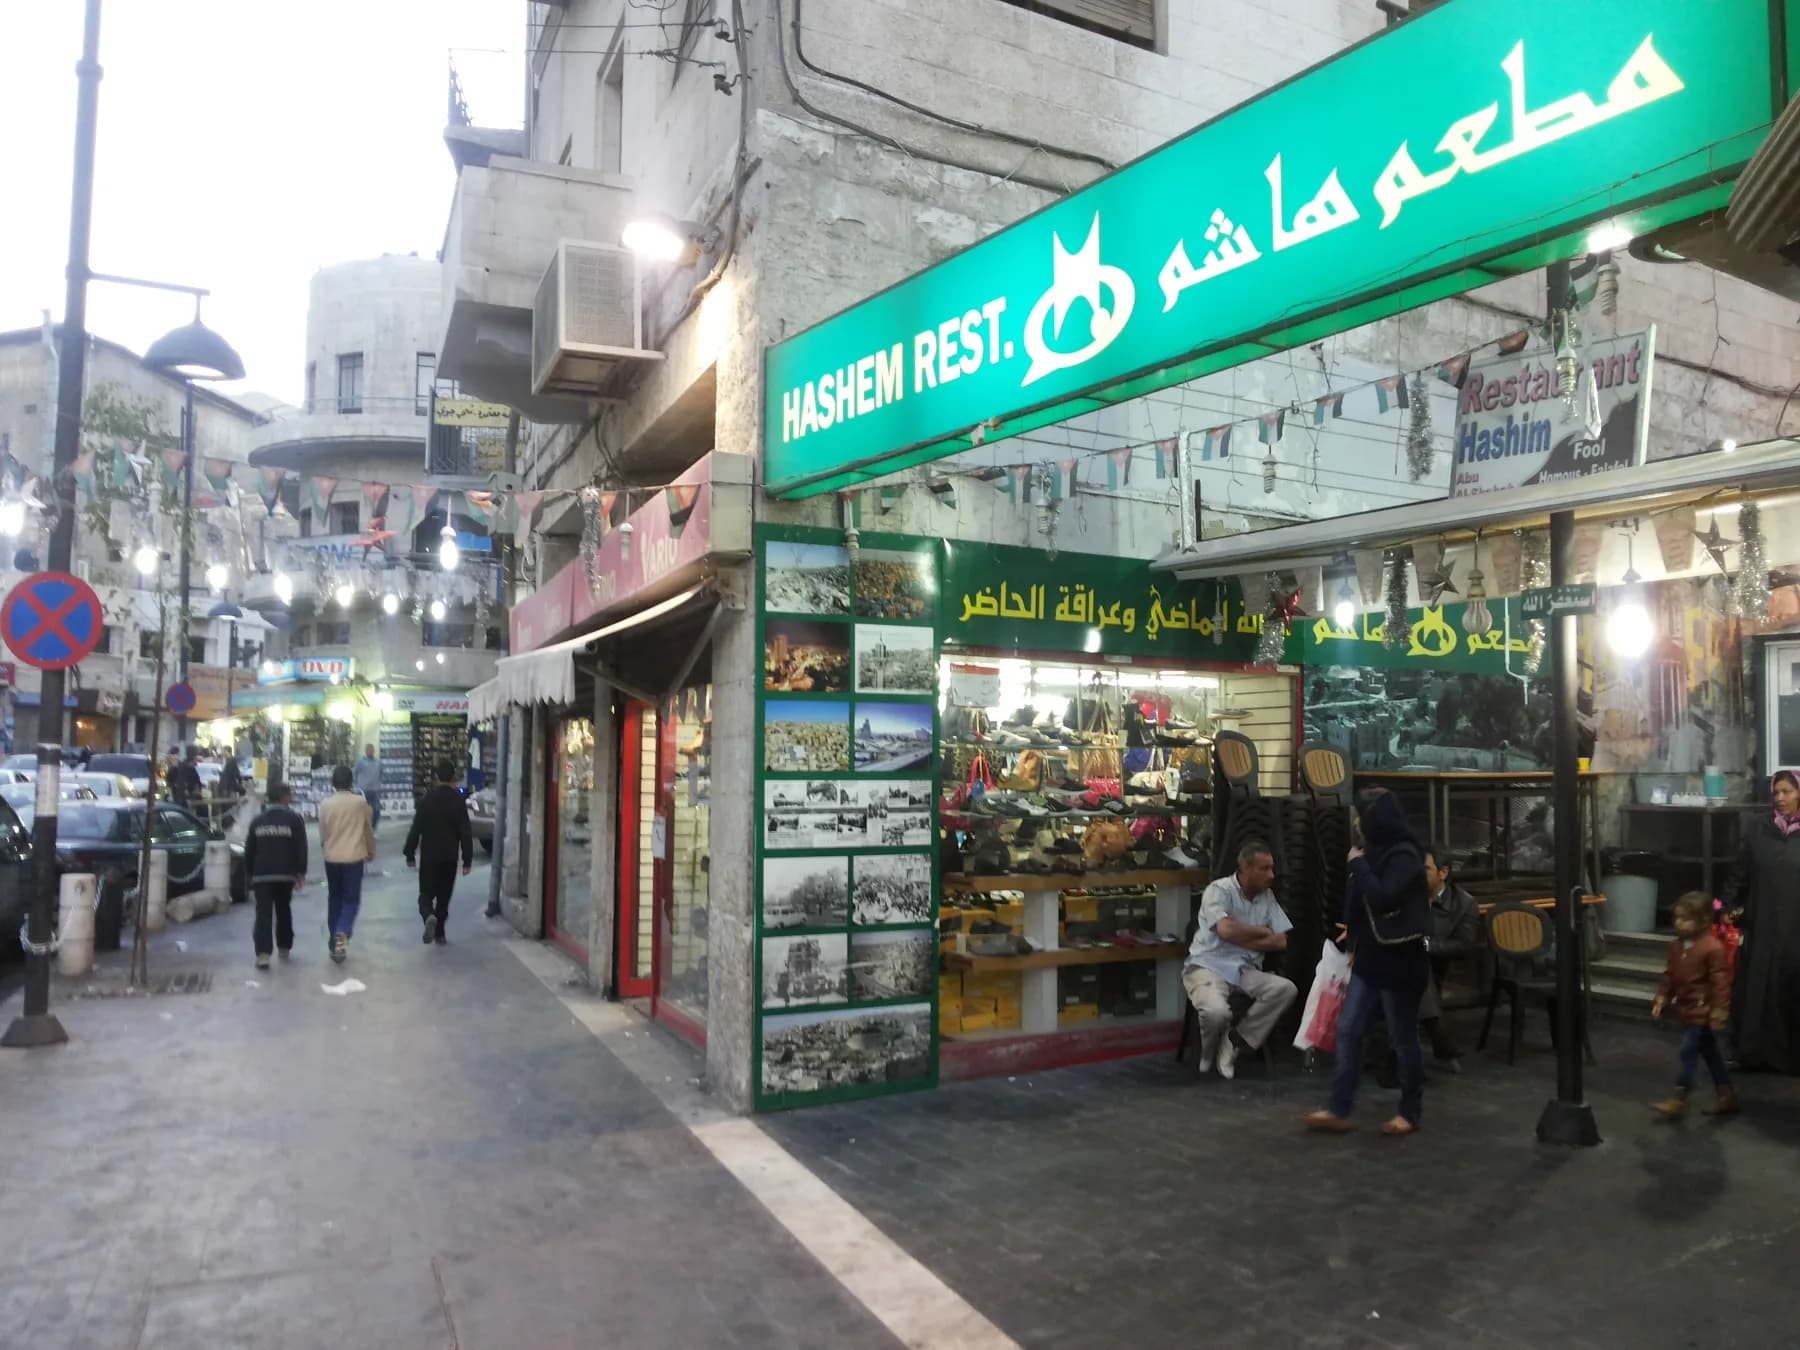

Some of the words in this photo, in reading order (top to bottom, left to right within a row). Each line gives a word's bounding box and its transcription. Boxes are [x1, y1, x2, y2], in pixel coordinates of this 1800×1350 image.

[1373, 32, 1685, 230] مطعم
[1158, 151, 1361, 313] هاشم
[783, 342, 903, 443] HASHEM
[914, 296, 1014, 393] REST.
[1458, 412, 1552, 464] Hashim
[1573, 438, 1606, 460] Fool
[1456, 471, 1480, 485] Abu
[958, 580, 1046, 623] الحاضر
[1055, 584, 1136, 633] وعراقة
[1146, 583, 1229, 640] اماضي
[1522, 594, 1544, 612] الله
[302, 660, 343, 674] DVD
